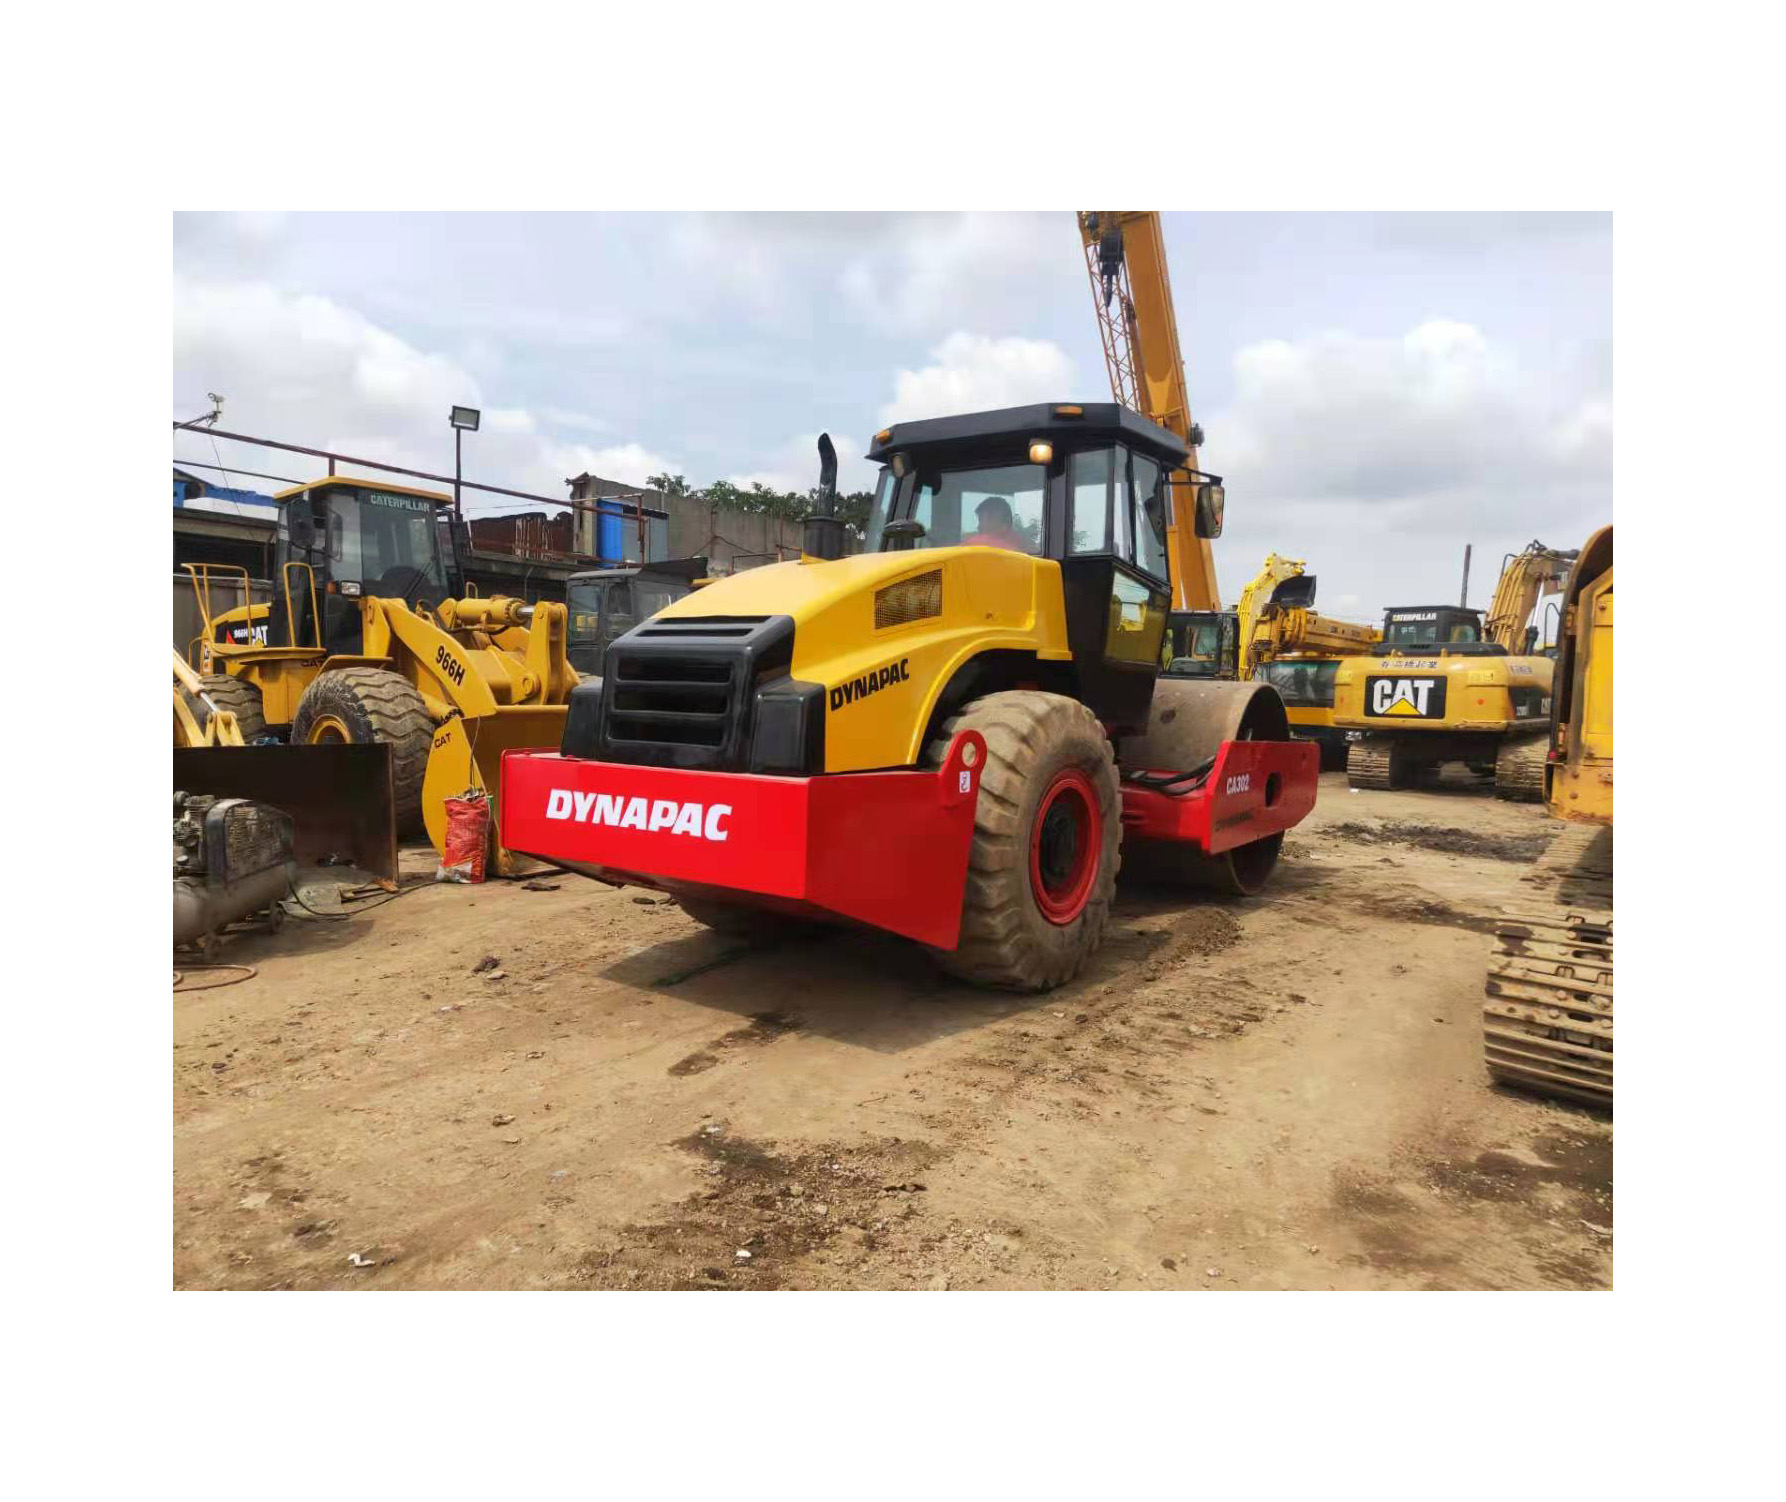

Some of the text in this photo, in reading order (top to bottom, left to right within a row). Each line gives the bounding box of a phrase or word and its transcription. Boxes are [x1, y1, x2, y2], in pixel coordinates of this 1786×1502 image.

[370, 494, 430, 512] CATERPILLAR
[435, 645, 465, 687] 966H
[830, 658, 909, 711] DYNAPAC
[1372, 679, 1435, 716] CAT
[434, 732, 452, 749] CAT
[1226, 773, 1250, 795] CA302
[546, 788, 732, 841] DYNAPAC
